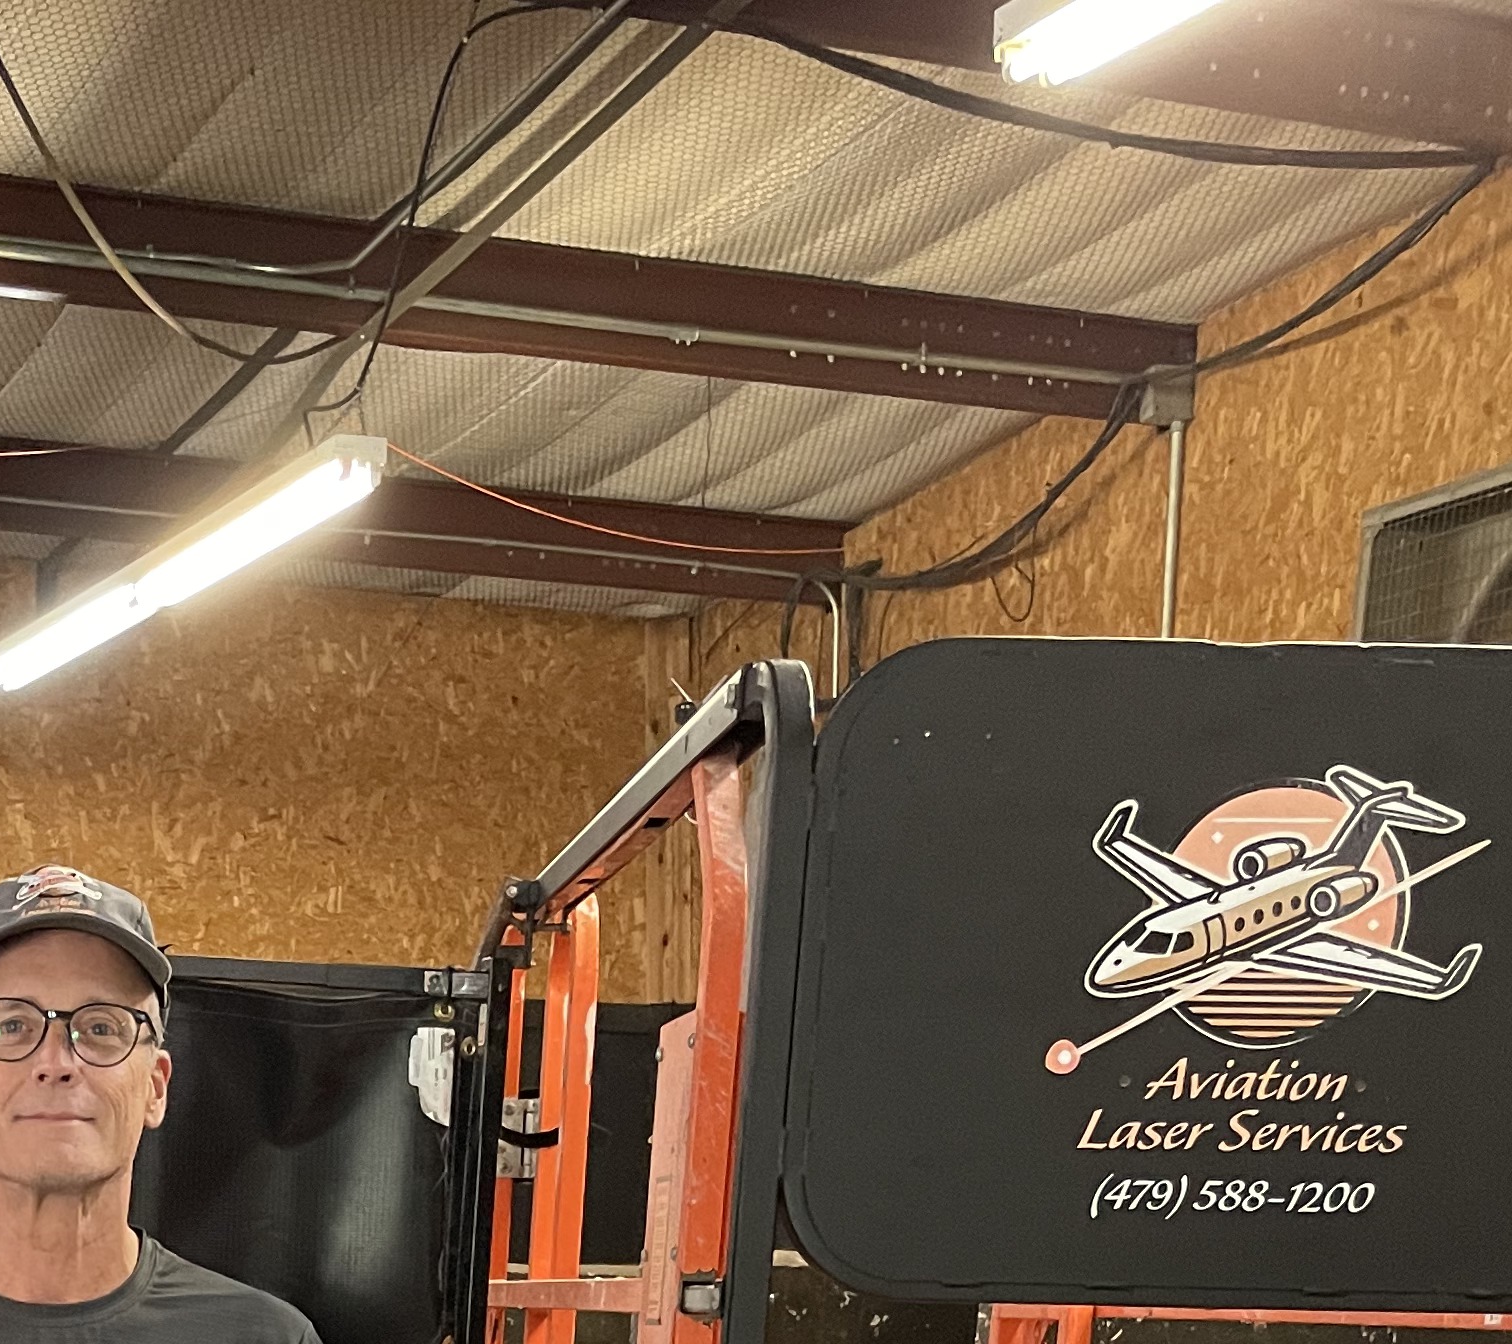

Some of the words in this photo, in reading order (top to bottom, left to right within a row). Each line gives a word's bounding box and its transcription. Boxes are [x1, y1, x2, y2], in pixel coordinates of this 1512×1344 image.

[1144, 1057, 1348, 1101] Aviation
[1076, 1108, 1215, 1151] Laser
[1217, 1109, 1408, 1153] Services
[1090, 1173, 1188, 1220] (479)
[1192, 1179, 1376, 1214] 588-1200
